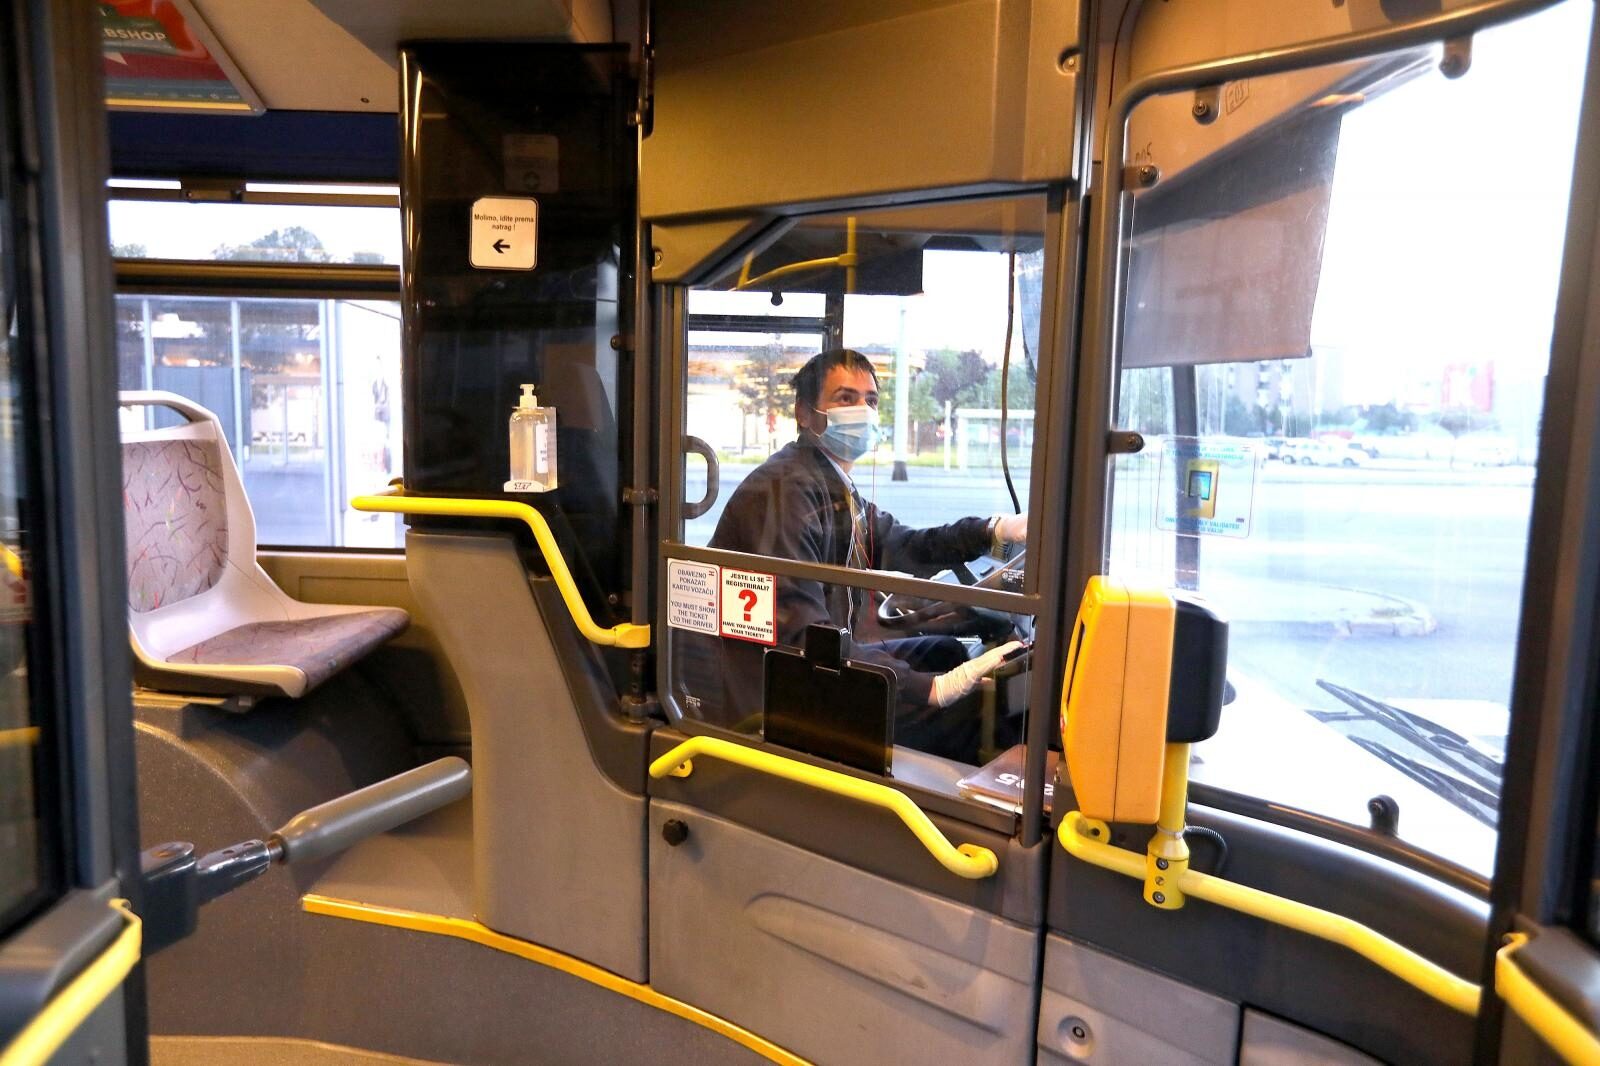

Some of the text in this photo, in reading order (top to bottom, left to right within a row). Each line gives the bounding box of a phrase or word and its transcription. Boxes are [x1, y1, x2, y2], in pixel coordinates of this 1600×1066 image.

[104, 28, 166, 41] BSHOP
[474, 214, 498, 222] Molimo,
[677, 569, 707, 579] OBAVEZNO
[730, 573, 748, 581] JESTE
[679, 577, 706, 586] POKAZATI
[726, 581, 770, 591] REGISTRIRALI?
[672, 583, 691, 593] KARTU
[683, 602, 697, 611] MUST
[699, 605, 715, 614] SHOW
[738, 590, 758, 622] ?
[689, 611, 708, 620] TICKET
[682, 617, 692, 625] THE
[692, 620, 713, 629] DRIVER
[745, 631, 765, 639] TICKET?
